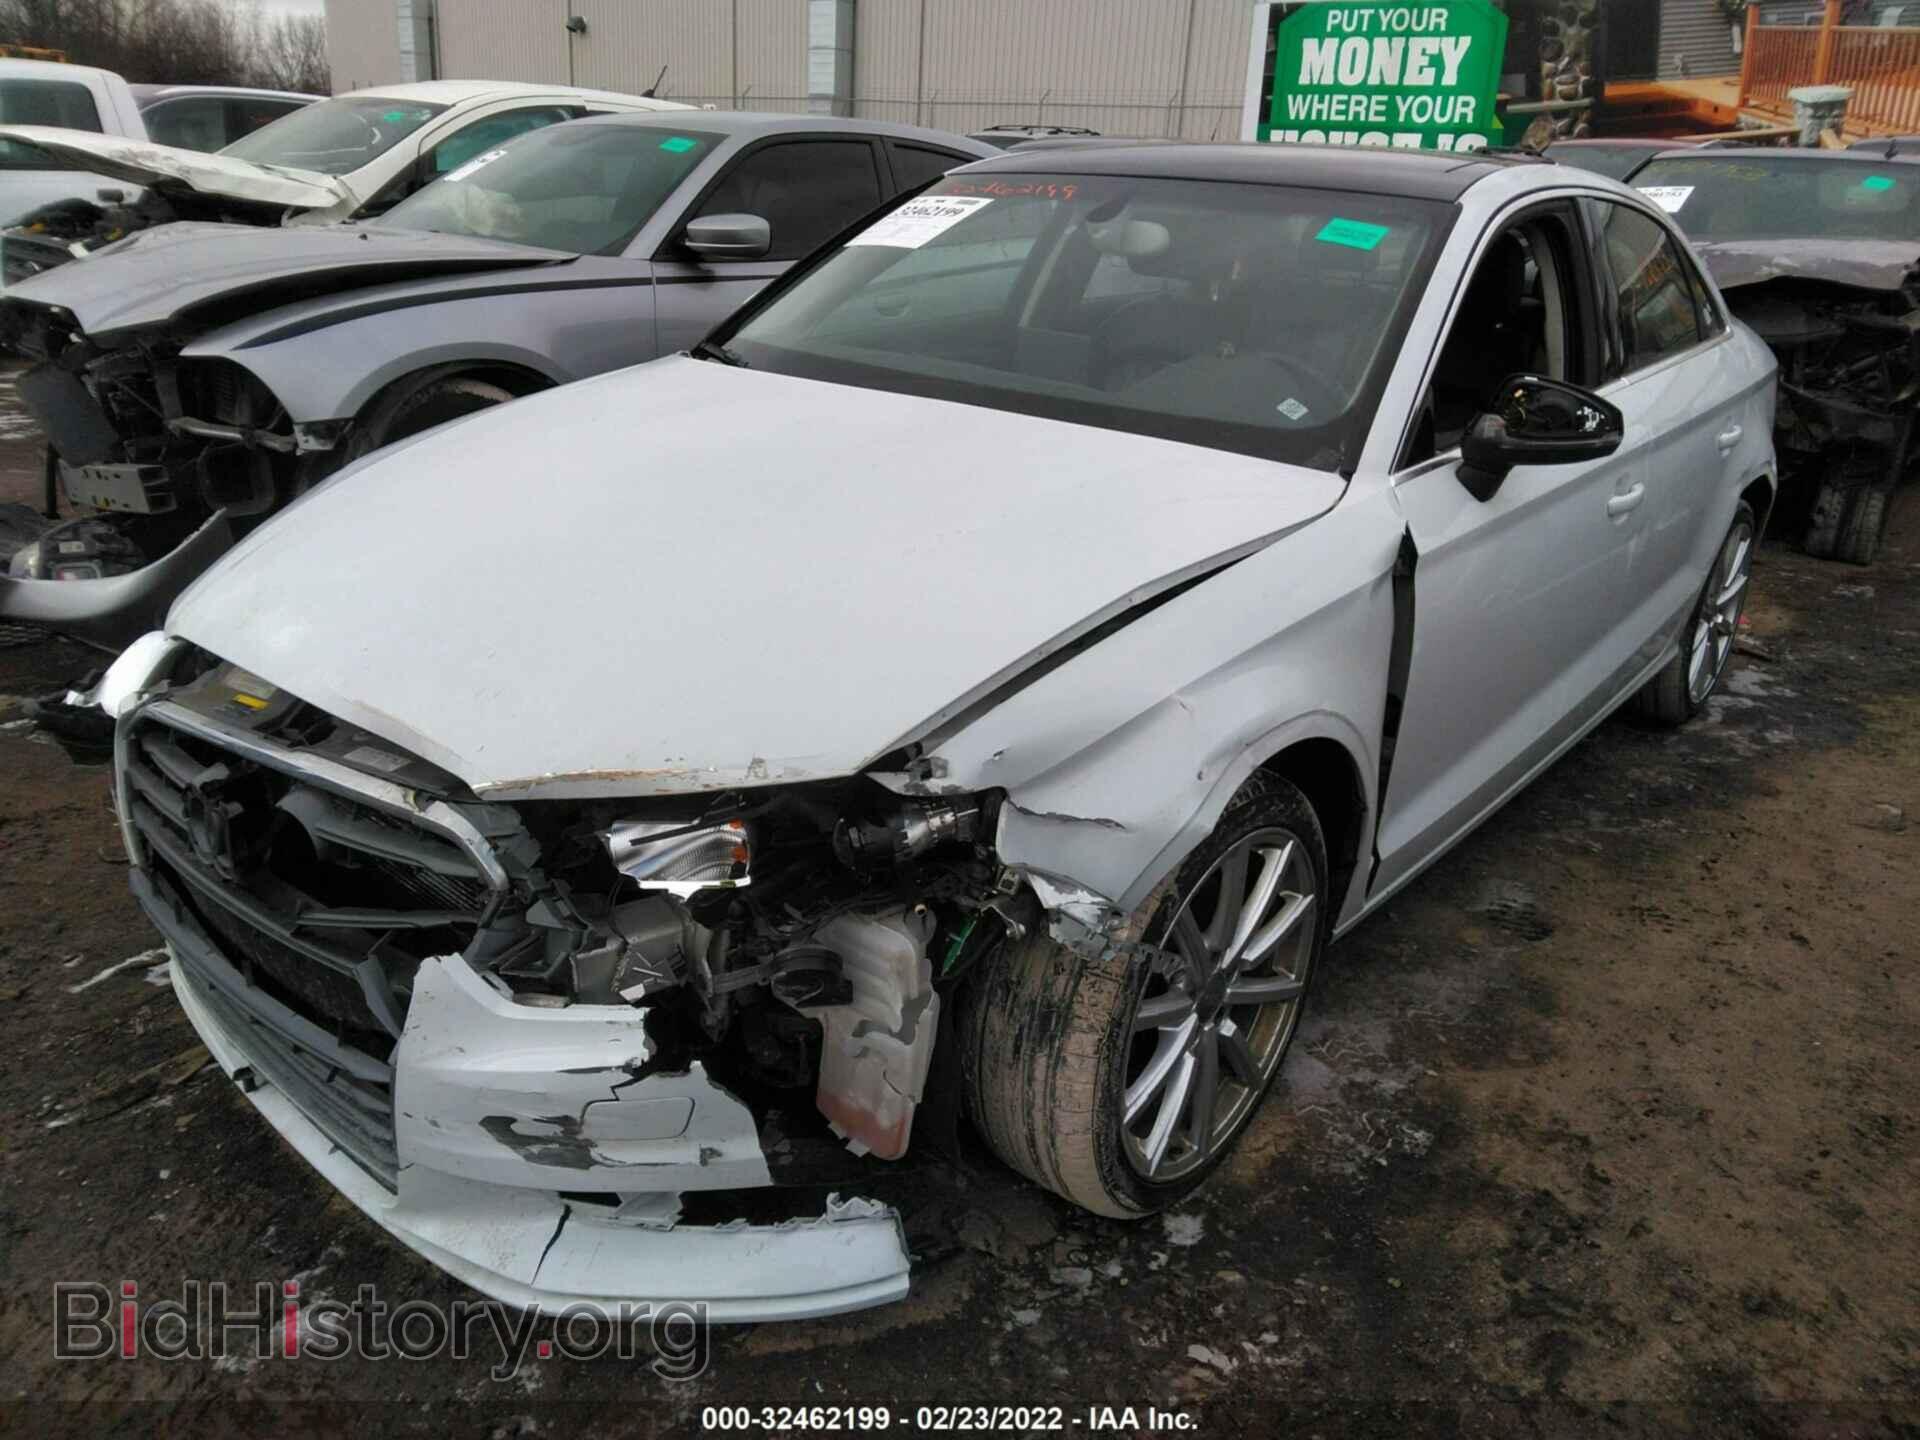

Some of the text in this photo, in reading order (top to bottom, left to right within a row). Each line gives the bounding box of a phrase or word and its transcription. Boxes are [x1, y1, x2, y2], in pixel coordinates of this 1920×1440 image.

[1326, 8, 1449, 32] PUT YOUR
[1298, 35, 1472, 86] MONEY
[1287, 94, 1476, 124] WHERE YOUR
